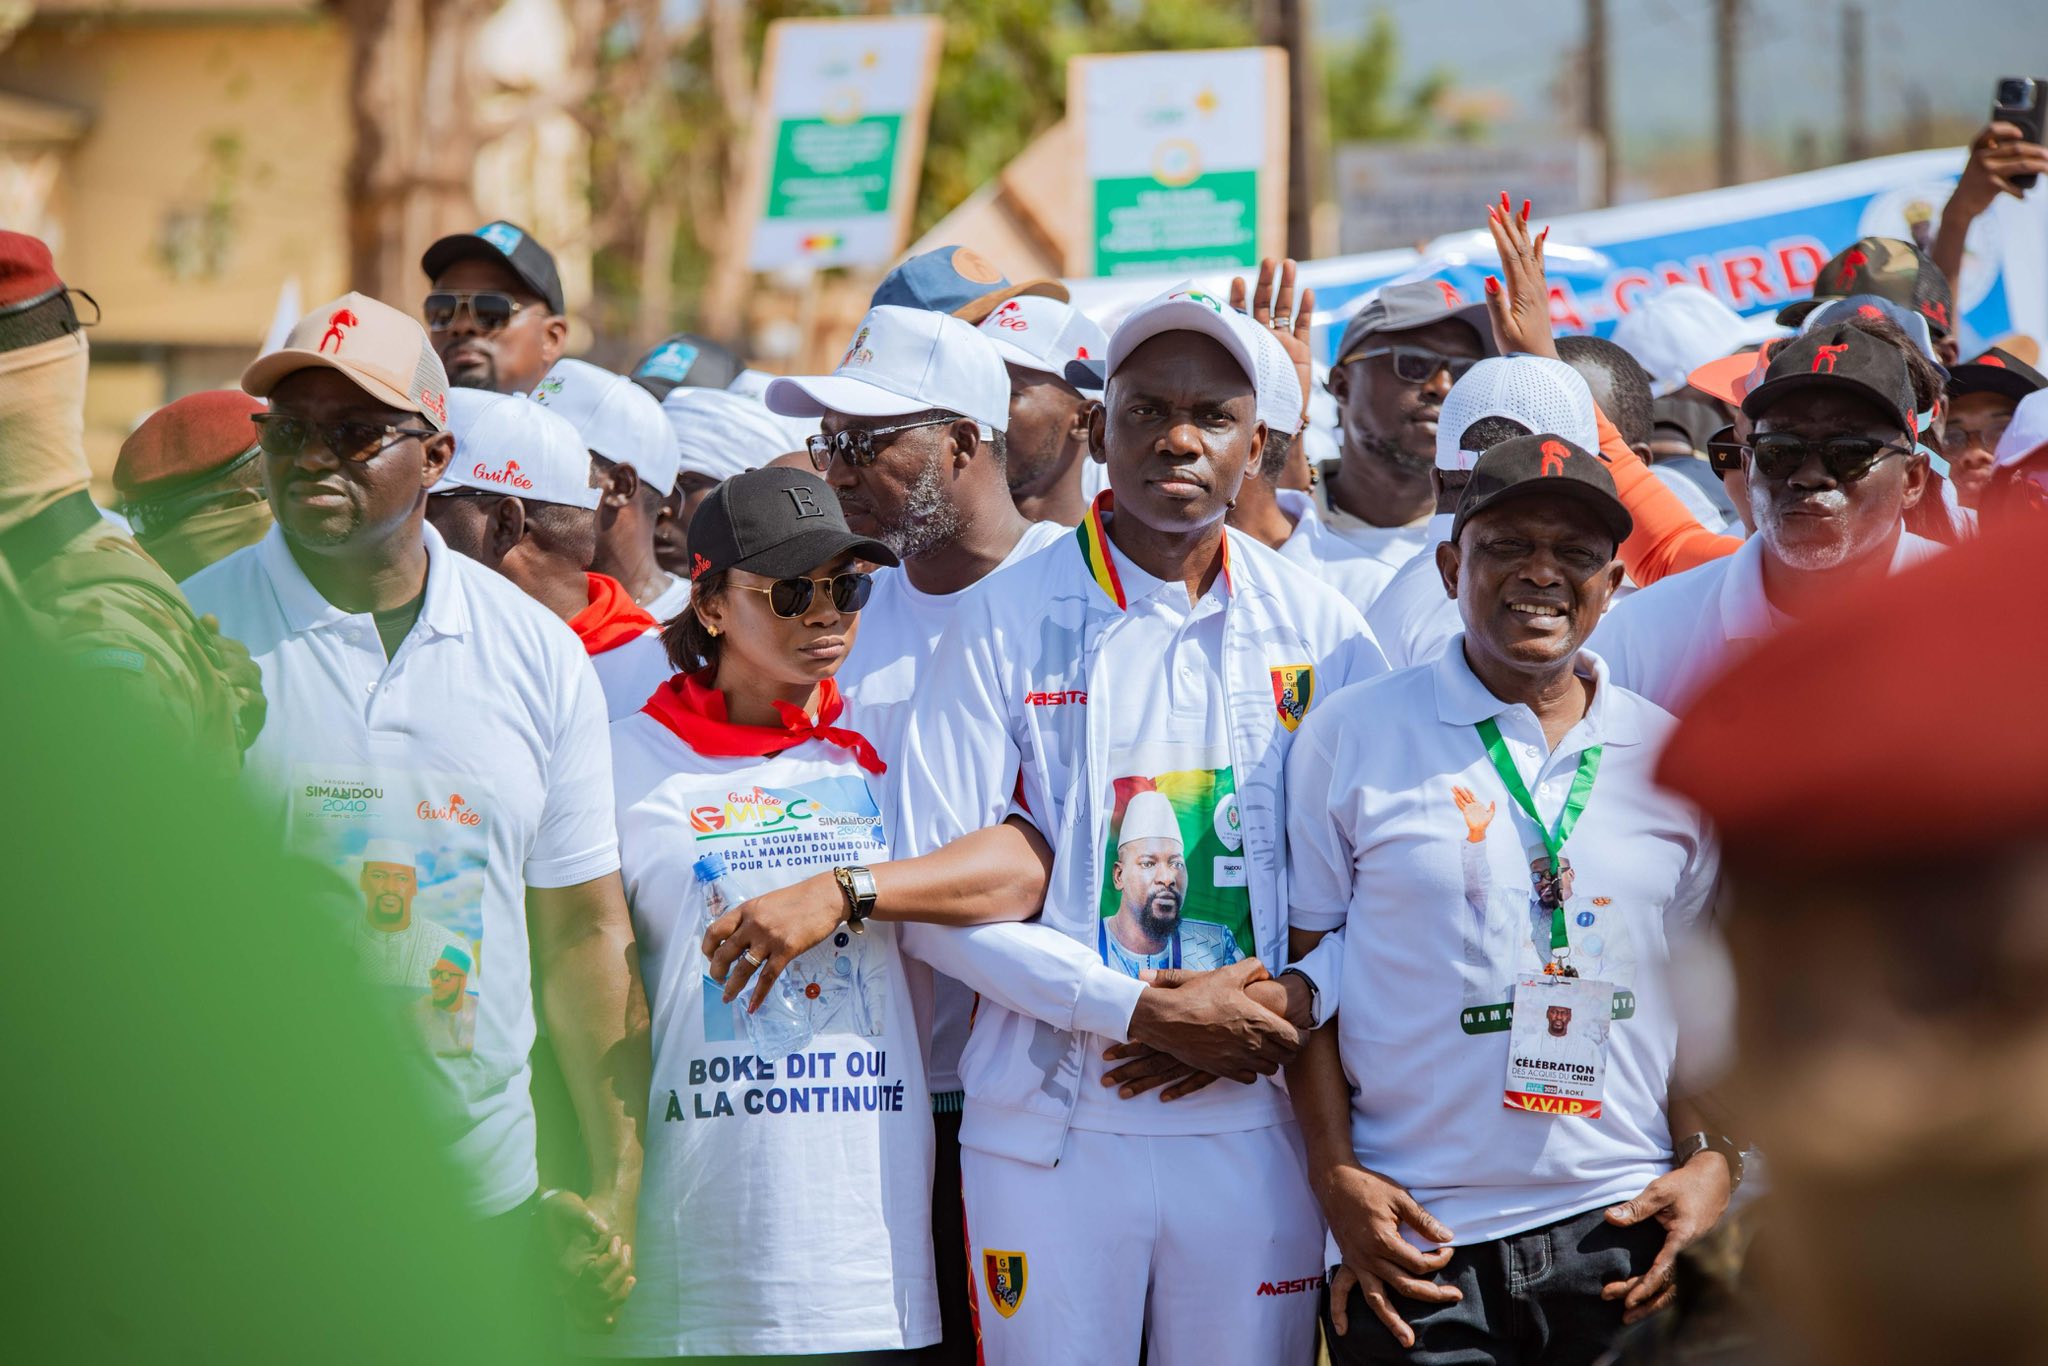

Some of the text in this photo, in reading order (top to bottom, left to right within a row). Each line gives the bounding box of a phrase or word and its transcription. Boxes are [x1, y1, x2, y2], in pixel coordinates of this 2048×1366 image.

[473, 460, 534, 490] Guinée
[781, 486, 825, 520] E
[305, 786, 384, 800] SIMANDOU
[728, 786, 782, 805] Guinée
[322, 799, 367, 812] 2040
[416, 793, 482, 826] Guinée
[744, 832, 835, 847] LE MOUVEMENT
[699, 842, 884, 861] ÉRAL MAMADI DOUMBOUYA
[731, 851, 860, 871] POUR LA CONTINUITÉ
[786, 1052, 836, 1079] DIT
[846, 1051, 886, 1078] OUI
[1515, 1057, 1594, 1075] CÉLÉBRATION
[1511, 1067, 1526, 1075] DES
[1527, 1069, 1557, 1079] ACQUIS
[1558, 1072, 1570, 1080] DU
[1571, 1074, 1596, 1083] CNRD
[664, 1080, 904, 1122] À LA CONTINUITÉ
